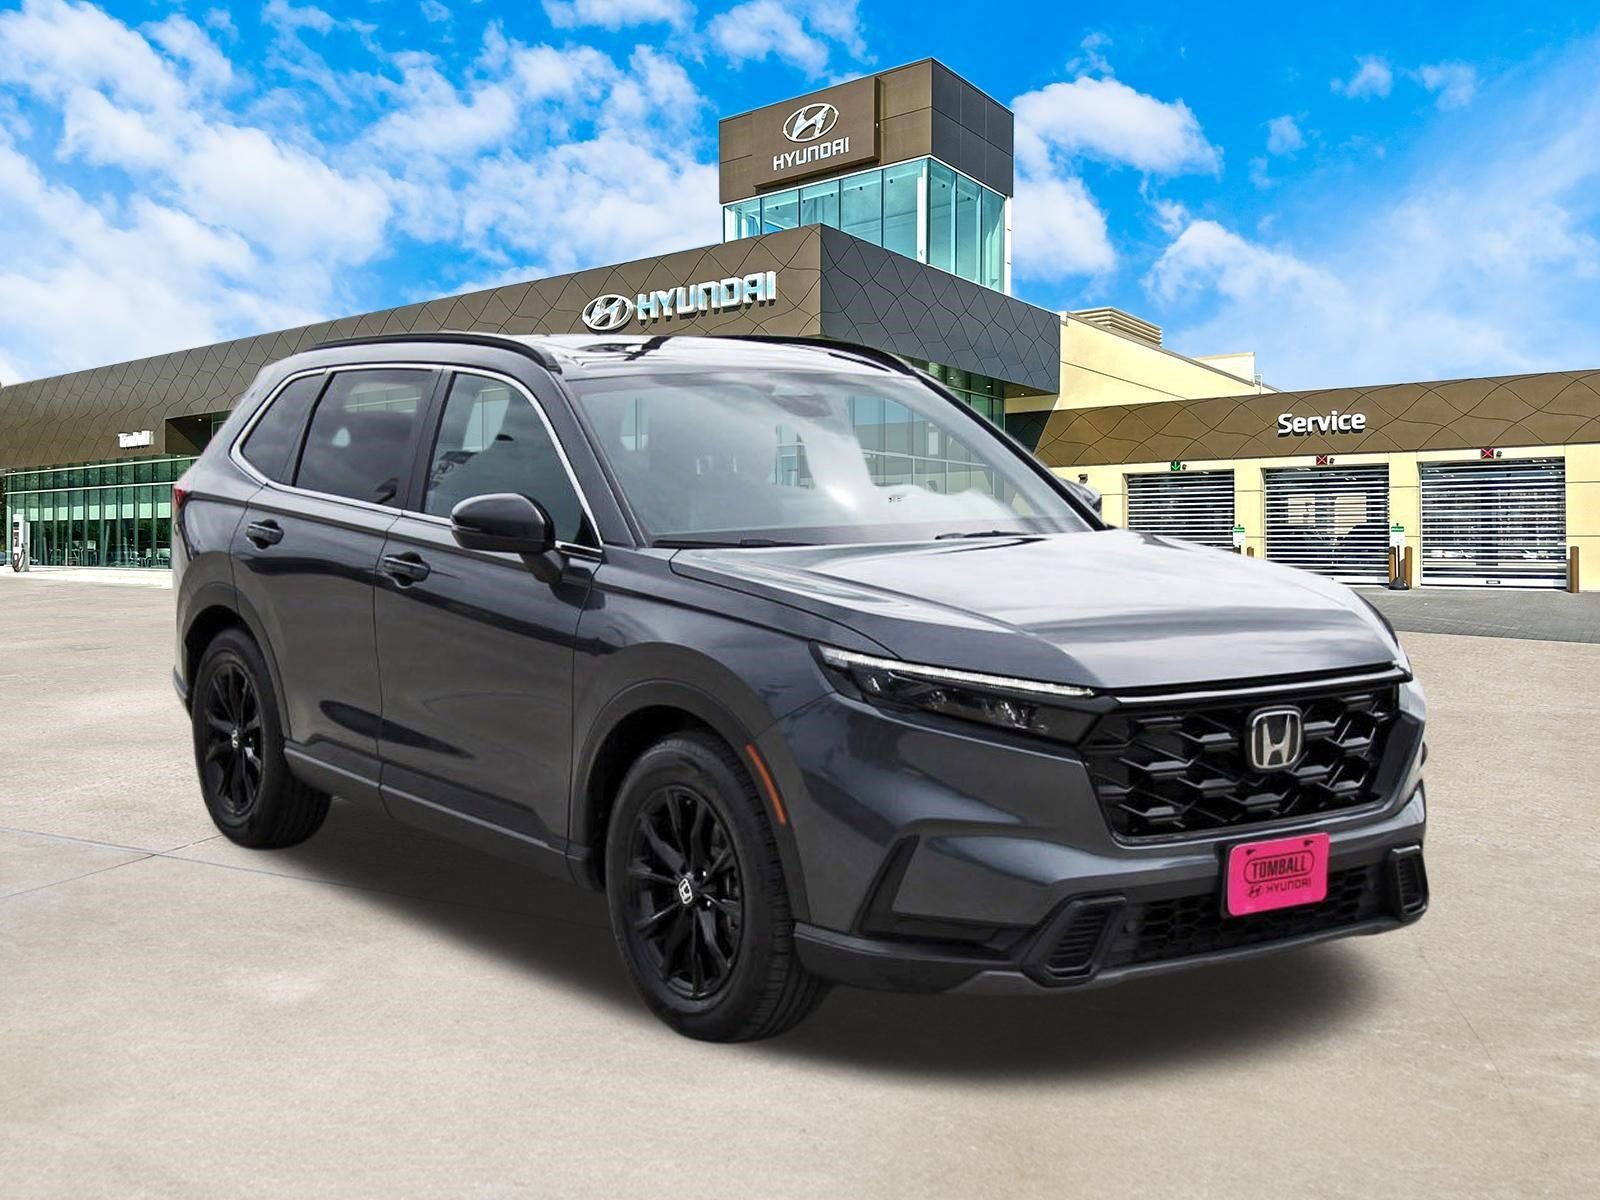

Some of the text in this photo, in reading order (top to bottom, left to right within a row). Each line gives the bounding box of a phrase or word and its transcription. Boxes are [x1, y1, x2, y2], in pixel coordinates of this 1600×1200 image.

[773, 137, 849, 171] HYUNDAI
[637, 270, 777, 322] HYUNDAI
[1277, 410, 1367, 435] Service
[1252, 855, 1307, 879] TOMBALL
[1265, 878, 1312, 893] HYUNDAI
